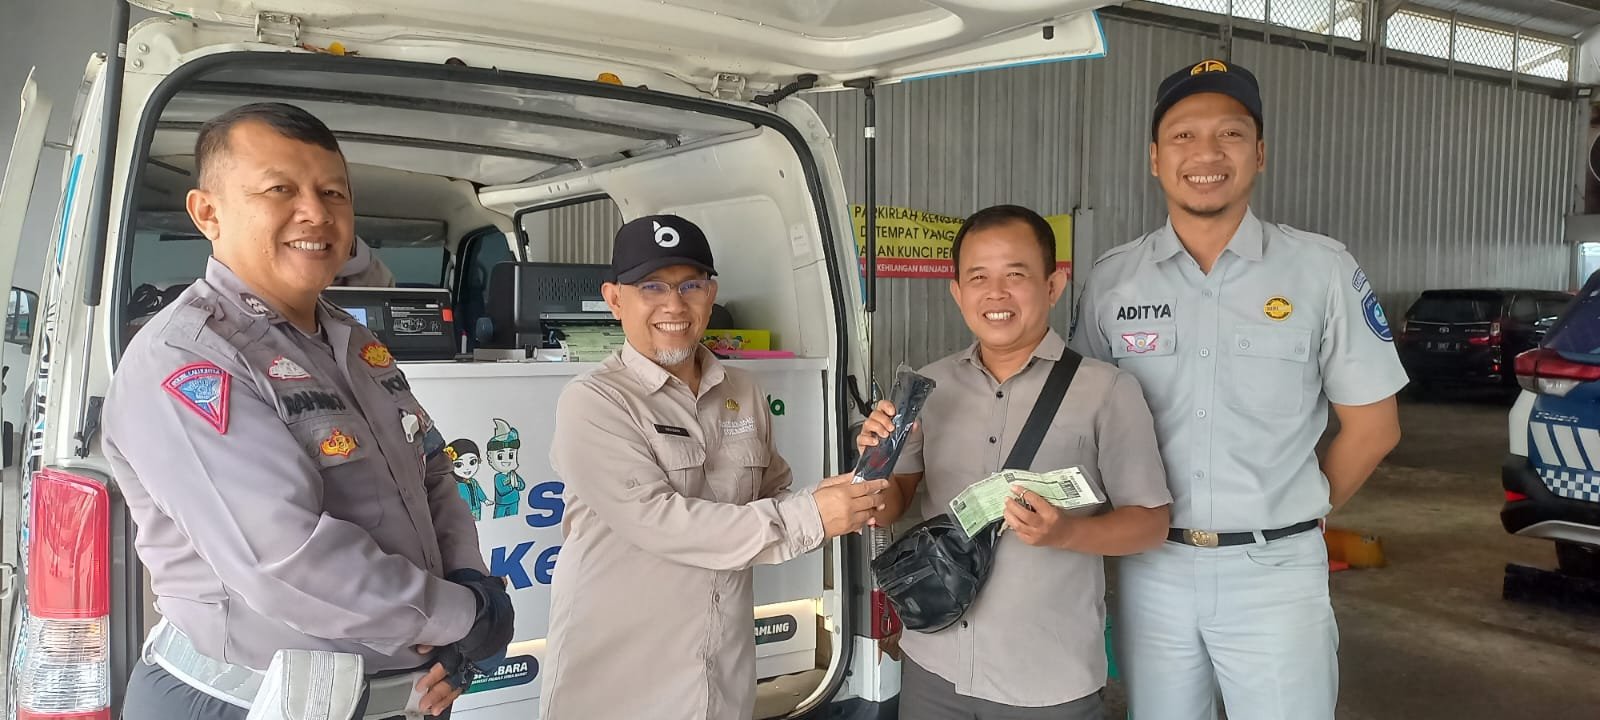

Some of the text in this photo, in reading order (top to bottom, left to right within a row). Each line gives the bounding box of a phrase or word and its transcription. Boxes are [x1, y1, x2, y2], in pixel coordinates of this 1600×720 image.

[854, 206, 918, 220] PKIRLAH
[875, 226, 919, 239] TEMPAT
[922, 228, 955, 242] YANG
[898, 246, 933, 258] KUNCI
[877, 263, 918, 273] KEHILANGAN
[919, 264, 949, 273] MENJADI
[1116, 303, 1172, 321] ADITYA
[525, 481, 565, 528] S
[490, 541, 562, 590] Ke
[473, 662, 528, 680] SBARA
